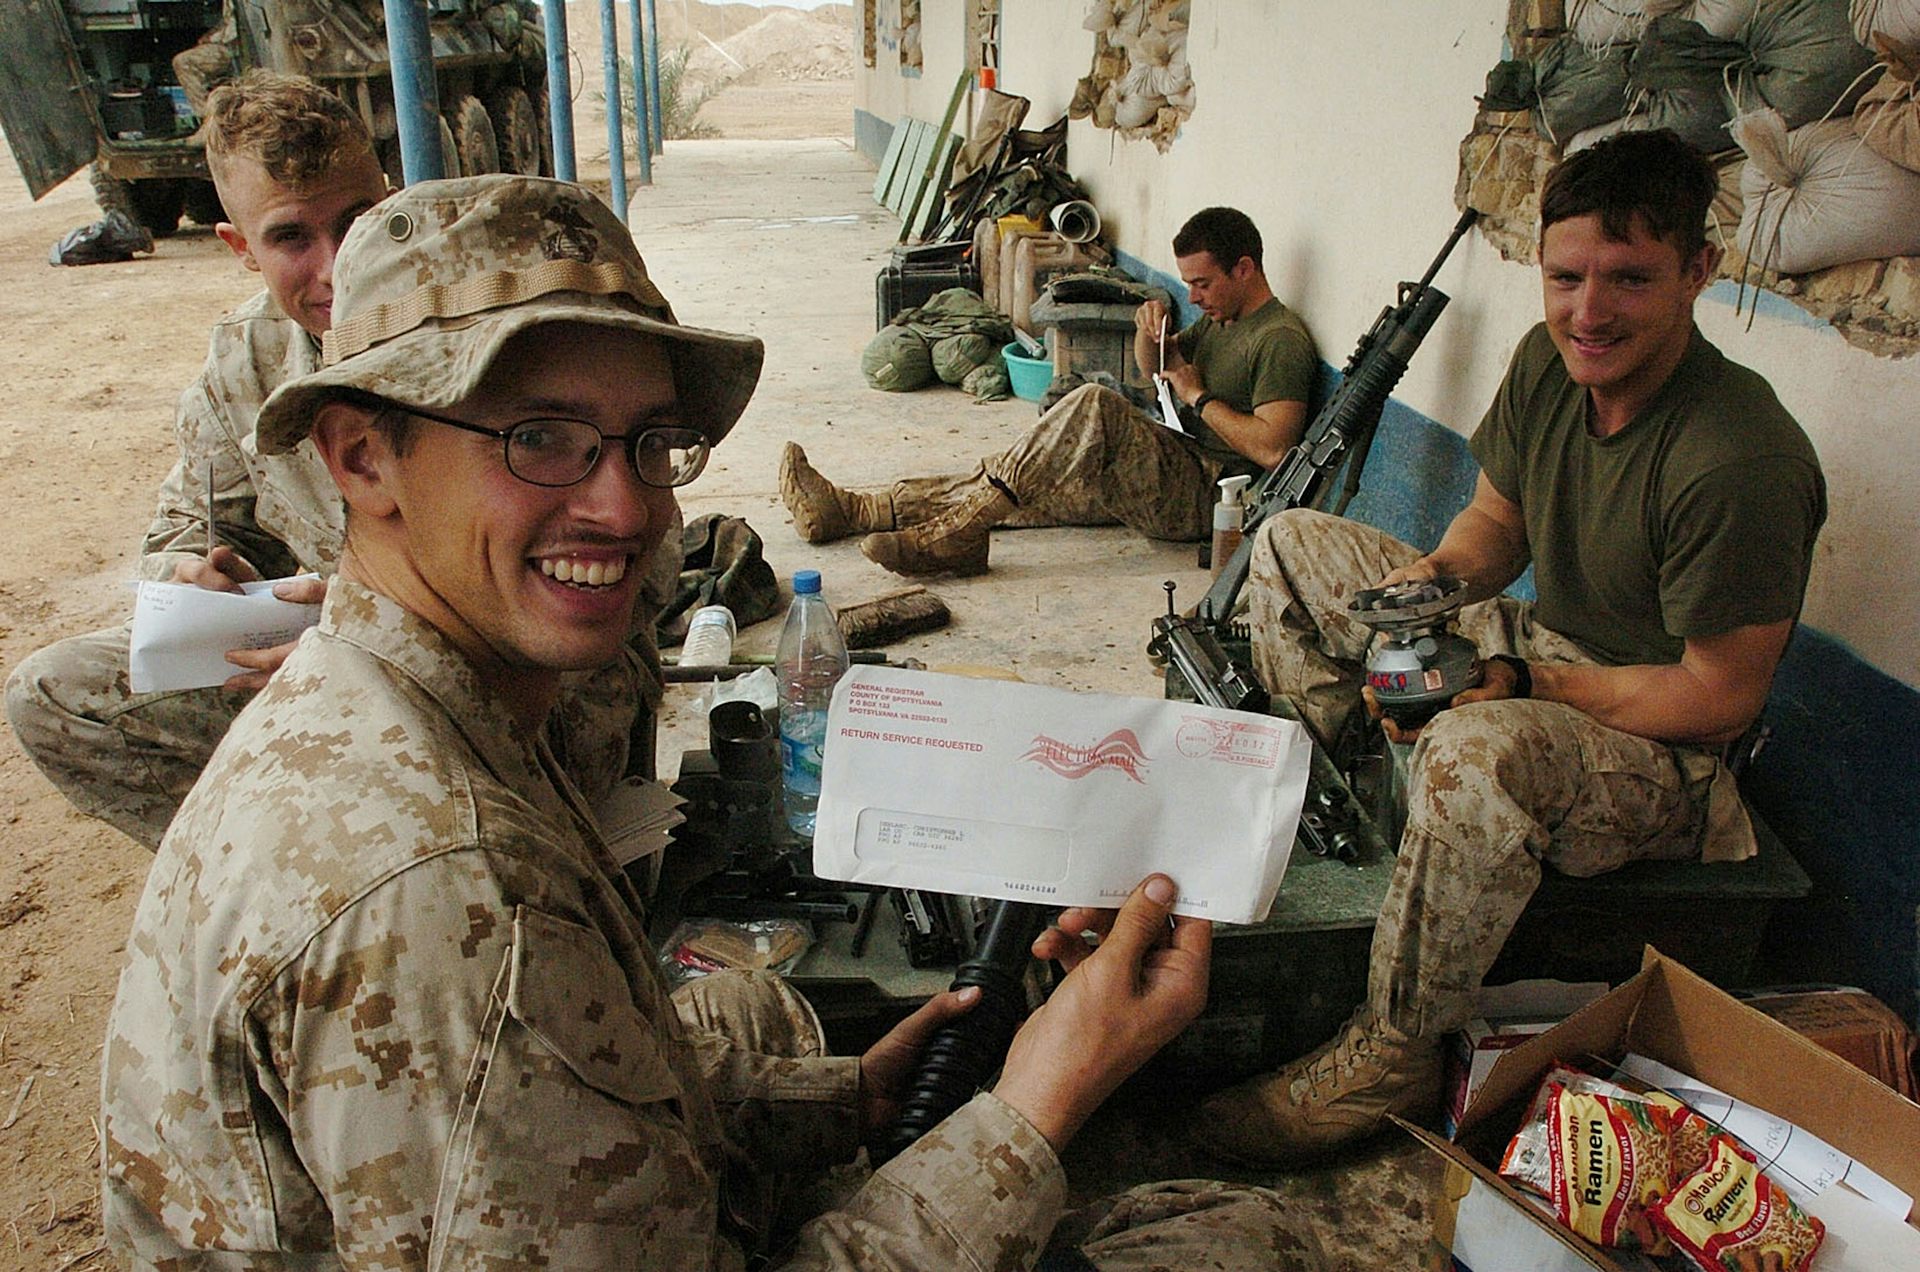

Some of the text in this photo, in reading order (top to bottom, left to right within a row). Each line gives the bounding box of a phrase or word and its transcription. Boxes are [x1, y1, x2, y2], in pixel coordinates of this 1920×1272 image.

[850, 691, 879, 699] COUNTY
[892, 696, 943, 707] SPOTSYLVANIA
[851, 683, 925, 697] GENERAL REGISTRAR
[848, 707, 898, 718] SPOTSYLVANIA
[841, 728, 984, 752] RETURN SERVICE REQUESTED
[1046, 747, 1104, 764] ELECTION
[1109, 755, 1136, 769] MAIL
[1568, 1115, 1581, 1193] Maruchan
[1584, 1120, 1603, 1206] Ramen
[1616, 1135, 1632, 1201] Beef Flavor
[1552, 1153, 1564, 1219] Maruchan
[1703, 1176, 1748, 1226] Ramen
[1753, 1200, 1769, 1228] Flavor
